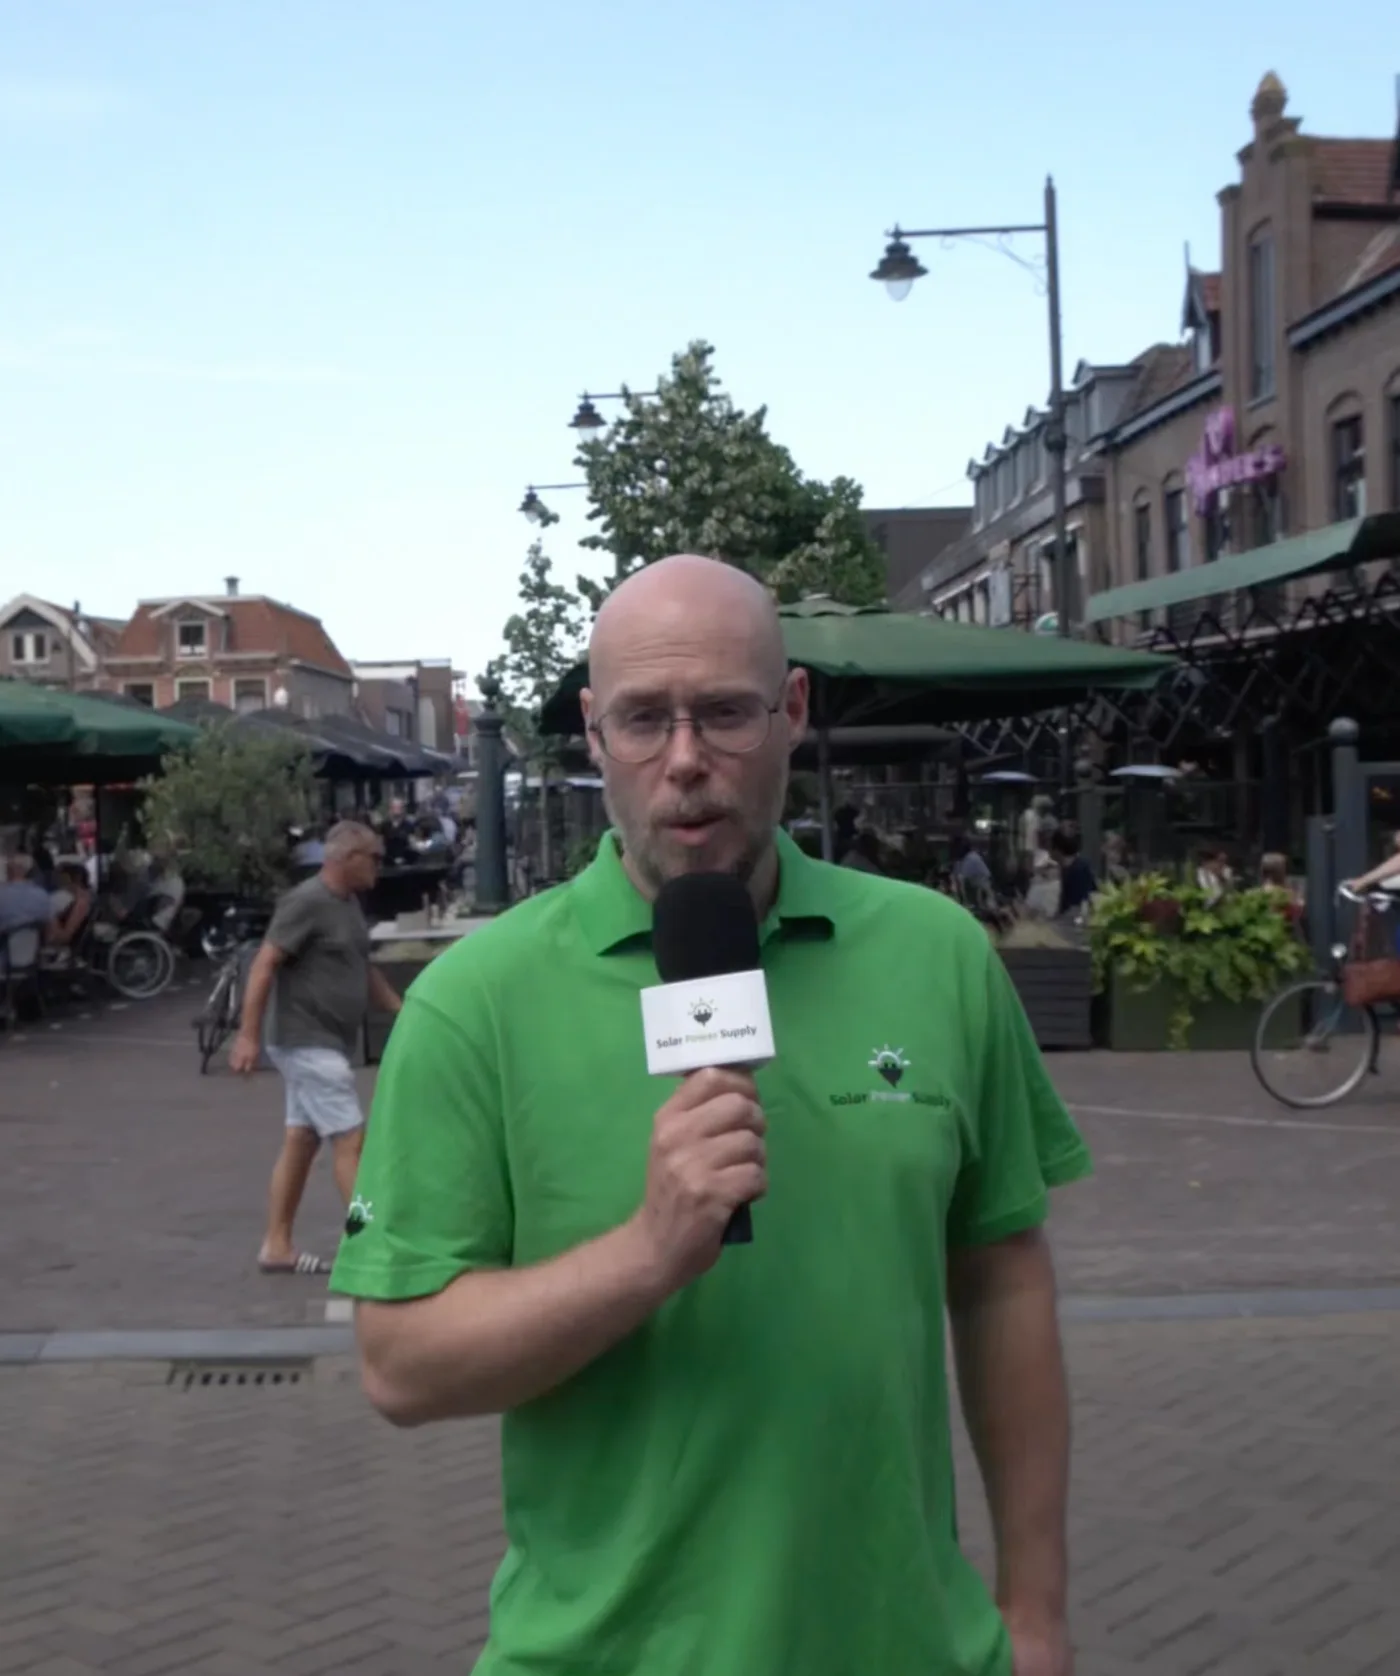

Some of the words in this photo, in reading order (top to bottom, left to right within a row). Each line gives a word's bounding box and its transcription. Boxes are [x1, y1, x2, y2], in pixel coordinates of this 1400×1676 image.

[656, 1036, 682, 1049] Solar
[719, 1025, 757, 1039] Supply
[829, 1092, 867, 1106] Solar
